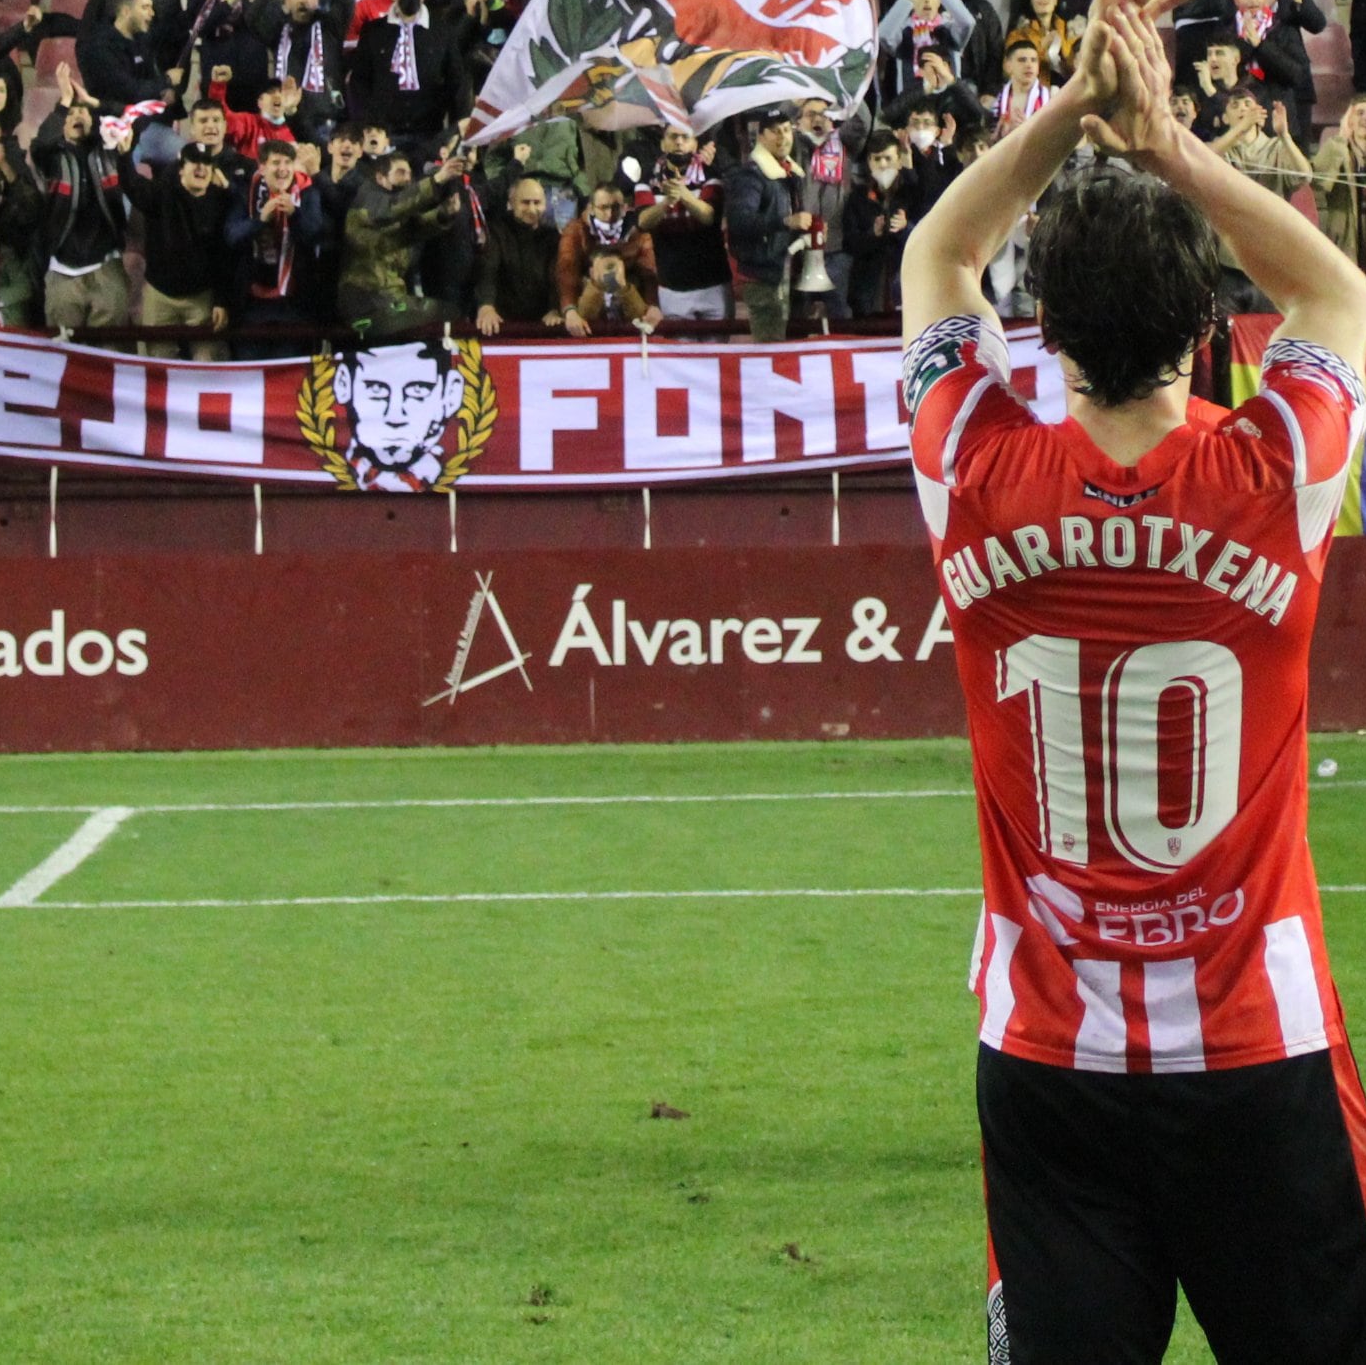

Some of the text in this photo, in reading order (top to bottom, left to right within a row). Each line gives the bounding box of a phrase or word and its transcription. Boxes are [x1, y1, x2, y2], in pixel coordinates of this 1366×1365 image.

[941, 515, 1299, 627] GUARROTXENA
[548, 583, 823, 667] Álvarez
[845, 596, 904, 662] &
[995, 635, 1244, 875] 10
[1095, 887, 1245, 947] EBRO
[1176, 885, 1208, 905] DEL
